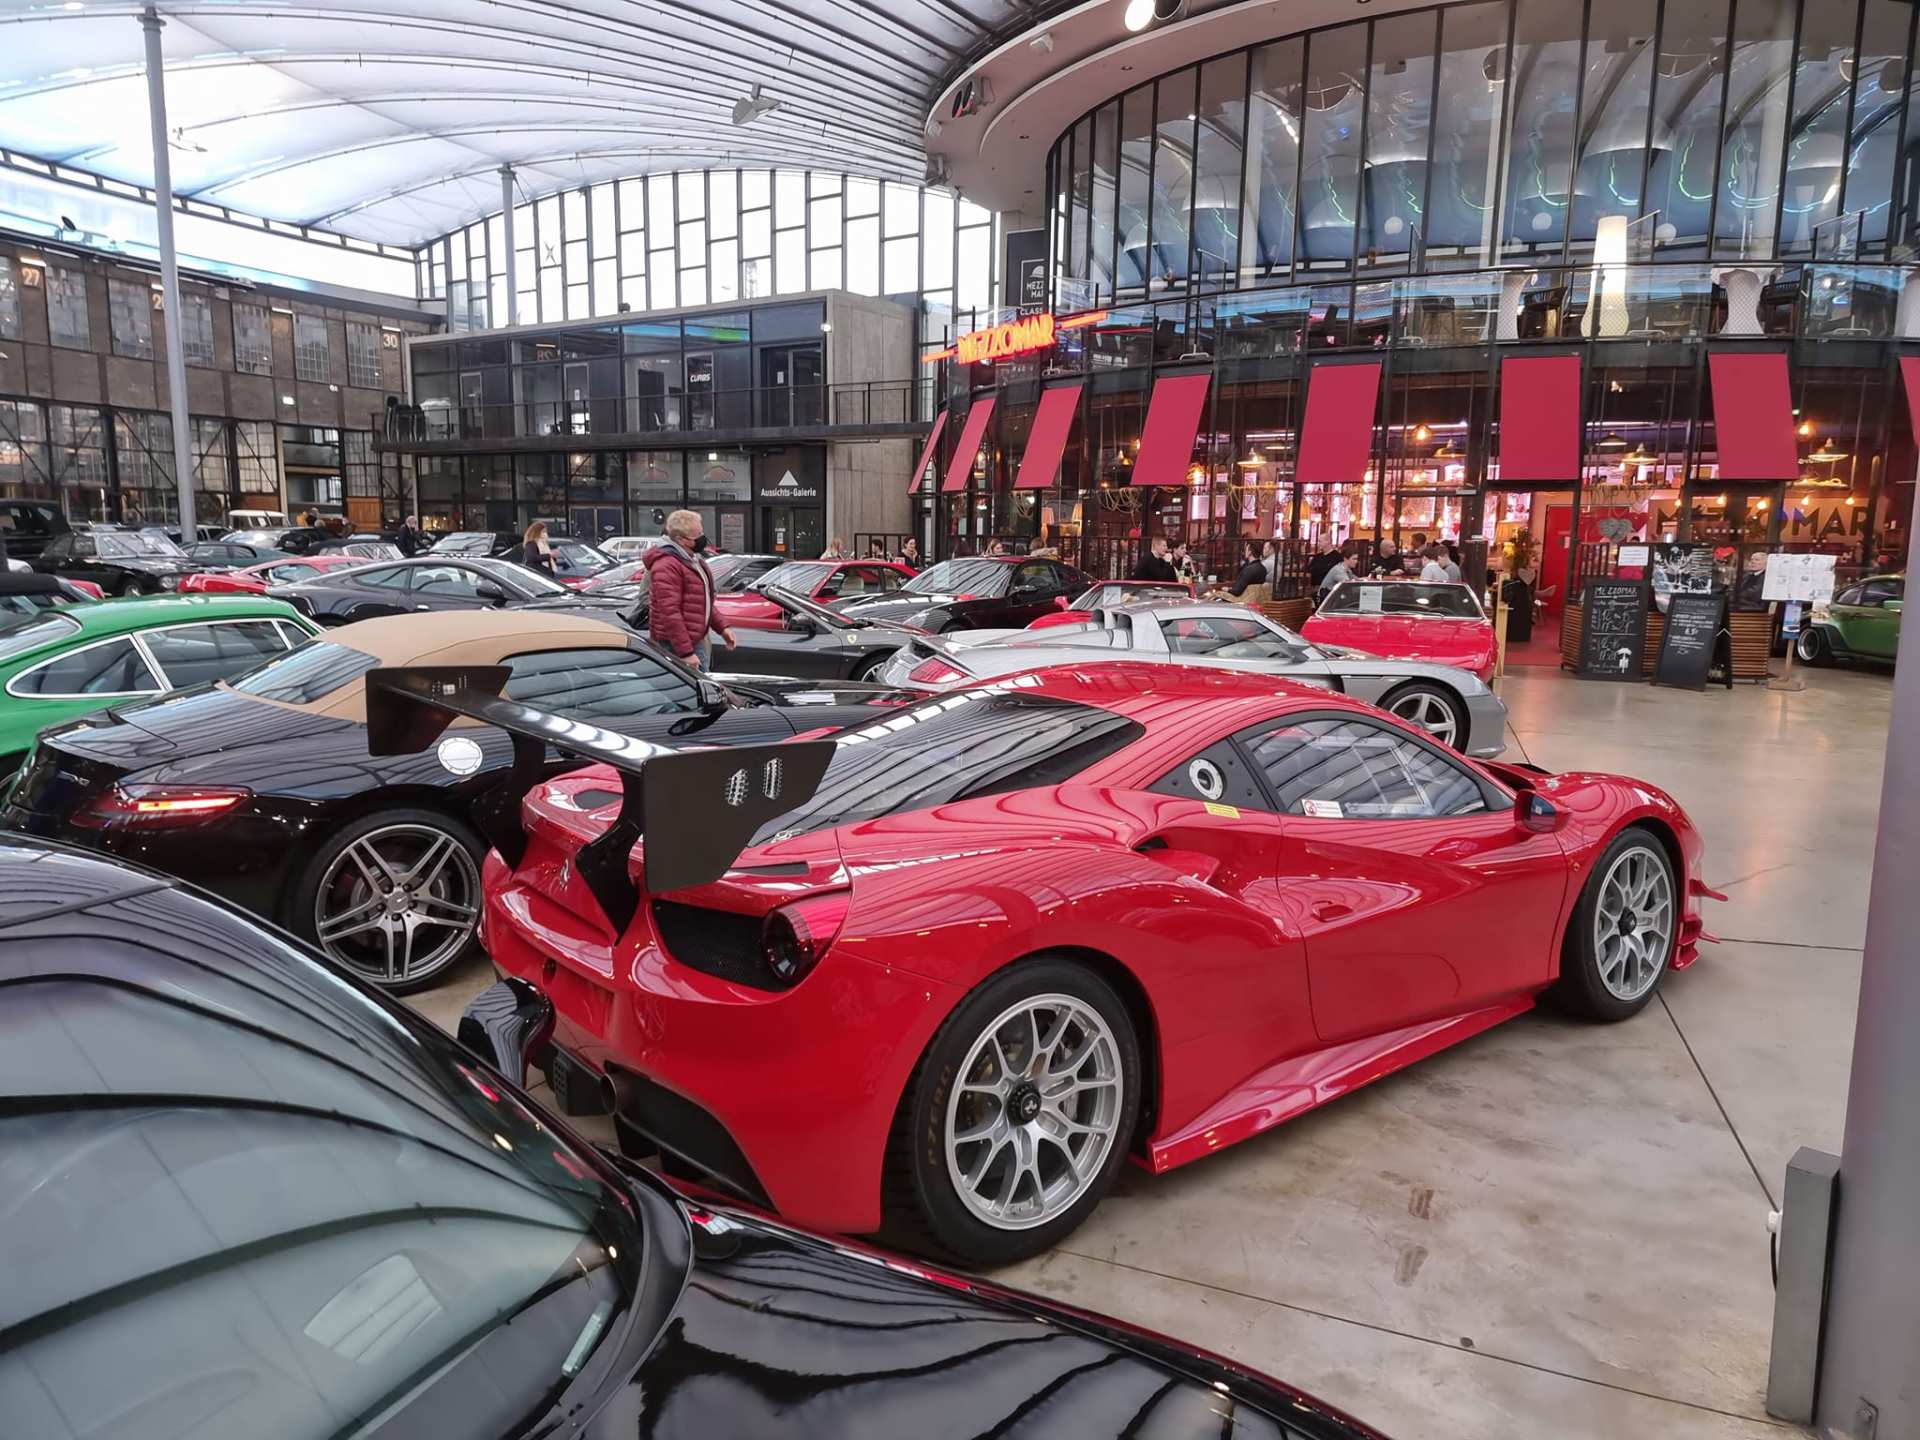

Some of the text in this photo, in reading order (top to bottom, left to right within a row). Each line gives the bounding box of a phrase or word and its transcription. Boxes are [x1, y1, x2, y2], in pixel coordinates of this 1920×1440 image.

[22, 267, 41, 287] 27
[152, 292, 165, 311] 2
[383, 333, 399, 348] 30
[957, 312, 1056, 366] MEZZOMAR
[760, 487, 817, 498] Aussichts-Galerie
